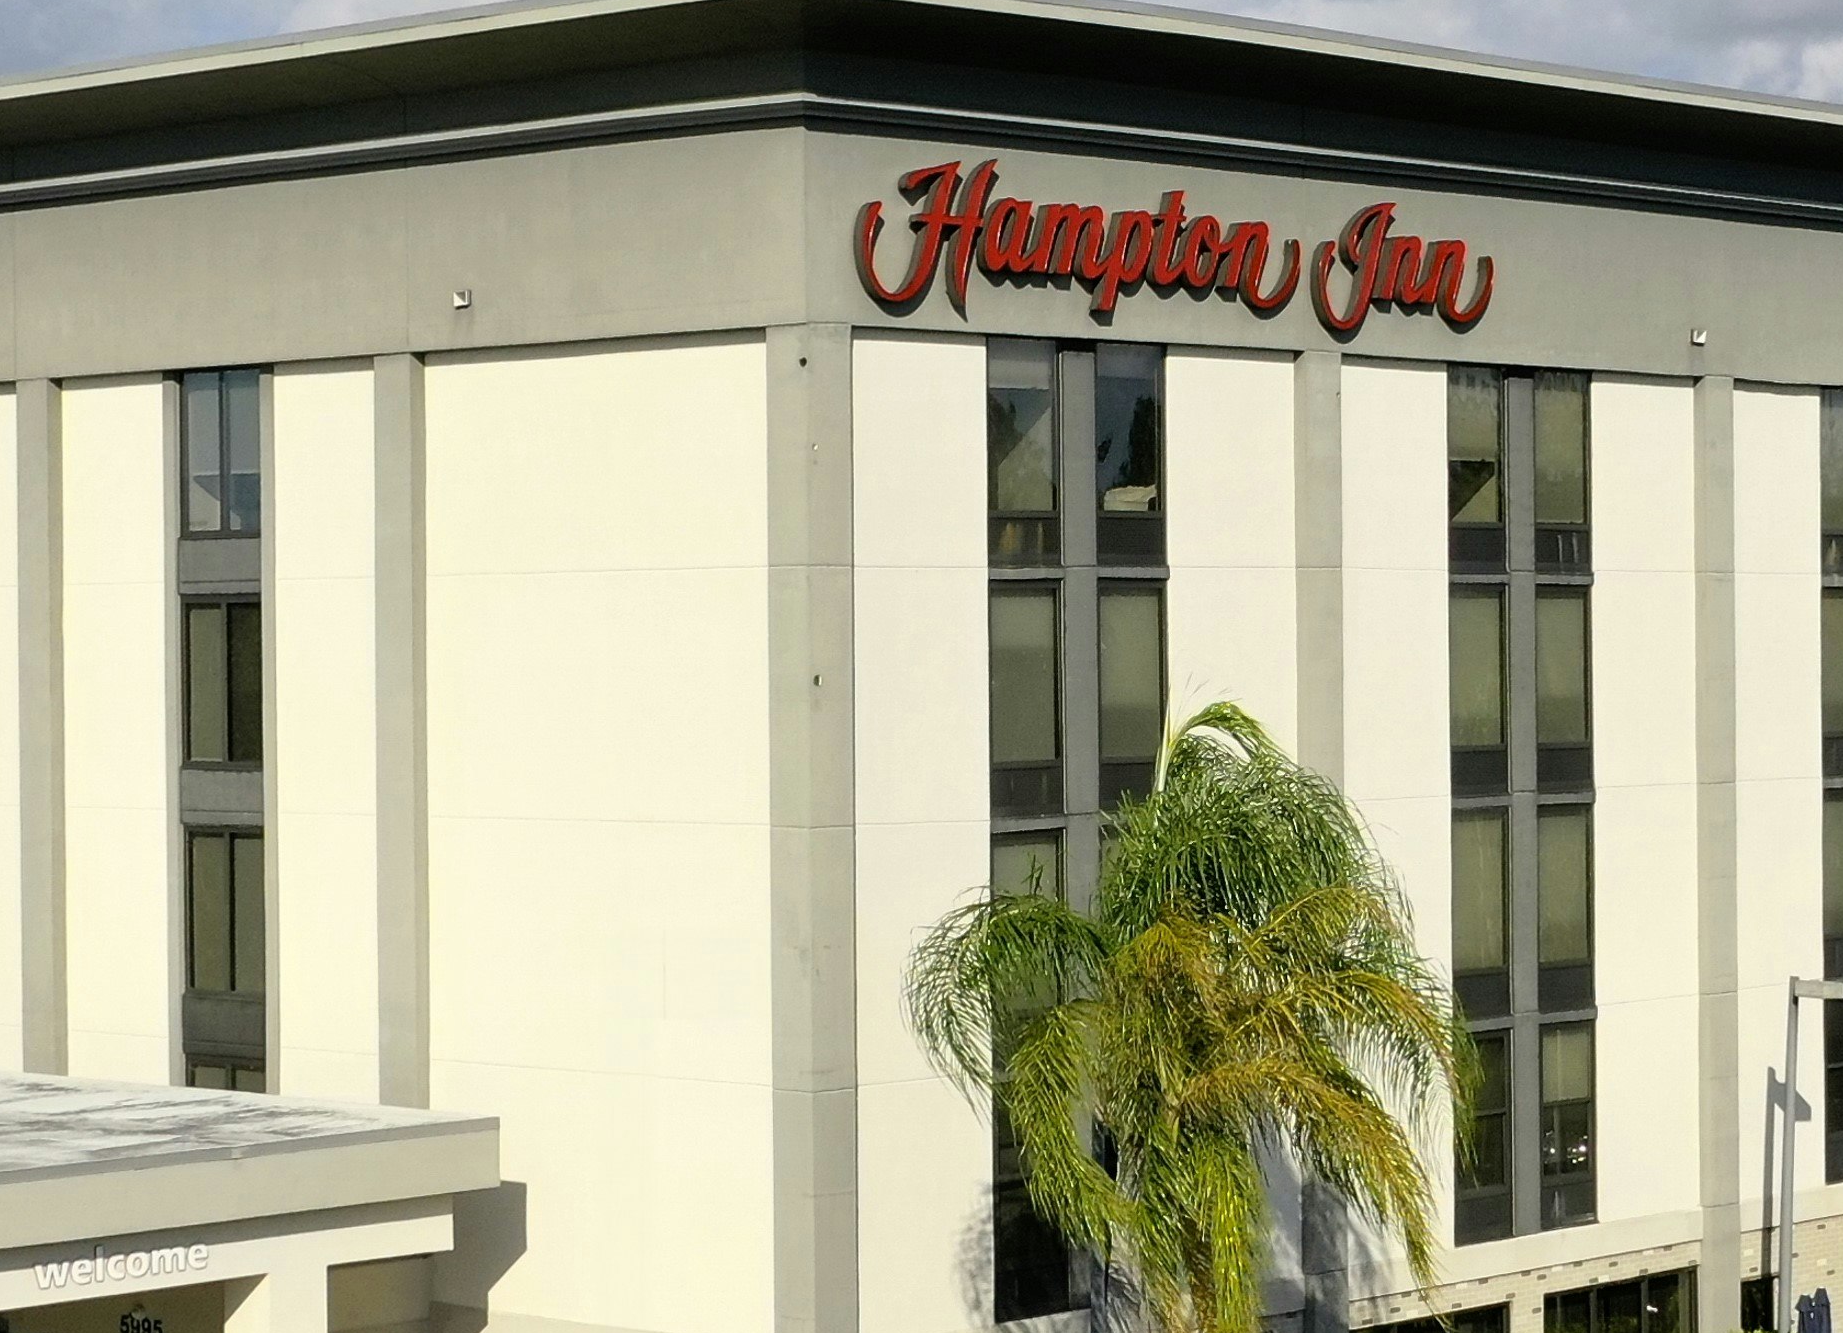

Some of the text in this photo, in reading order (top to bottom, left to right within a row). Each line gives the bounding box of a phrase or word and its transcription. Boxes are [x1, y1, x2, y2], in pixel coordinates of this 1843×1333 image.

[855, 159, 1495, 344] Hampton Inn
[33, 1243, 209, 1290] welcome
